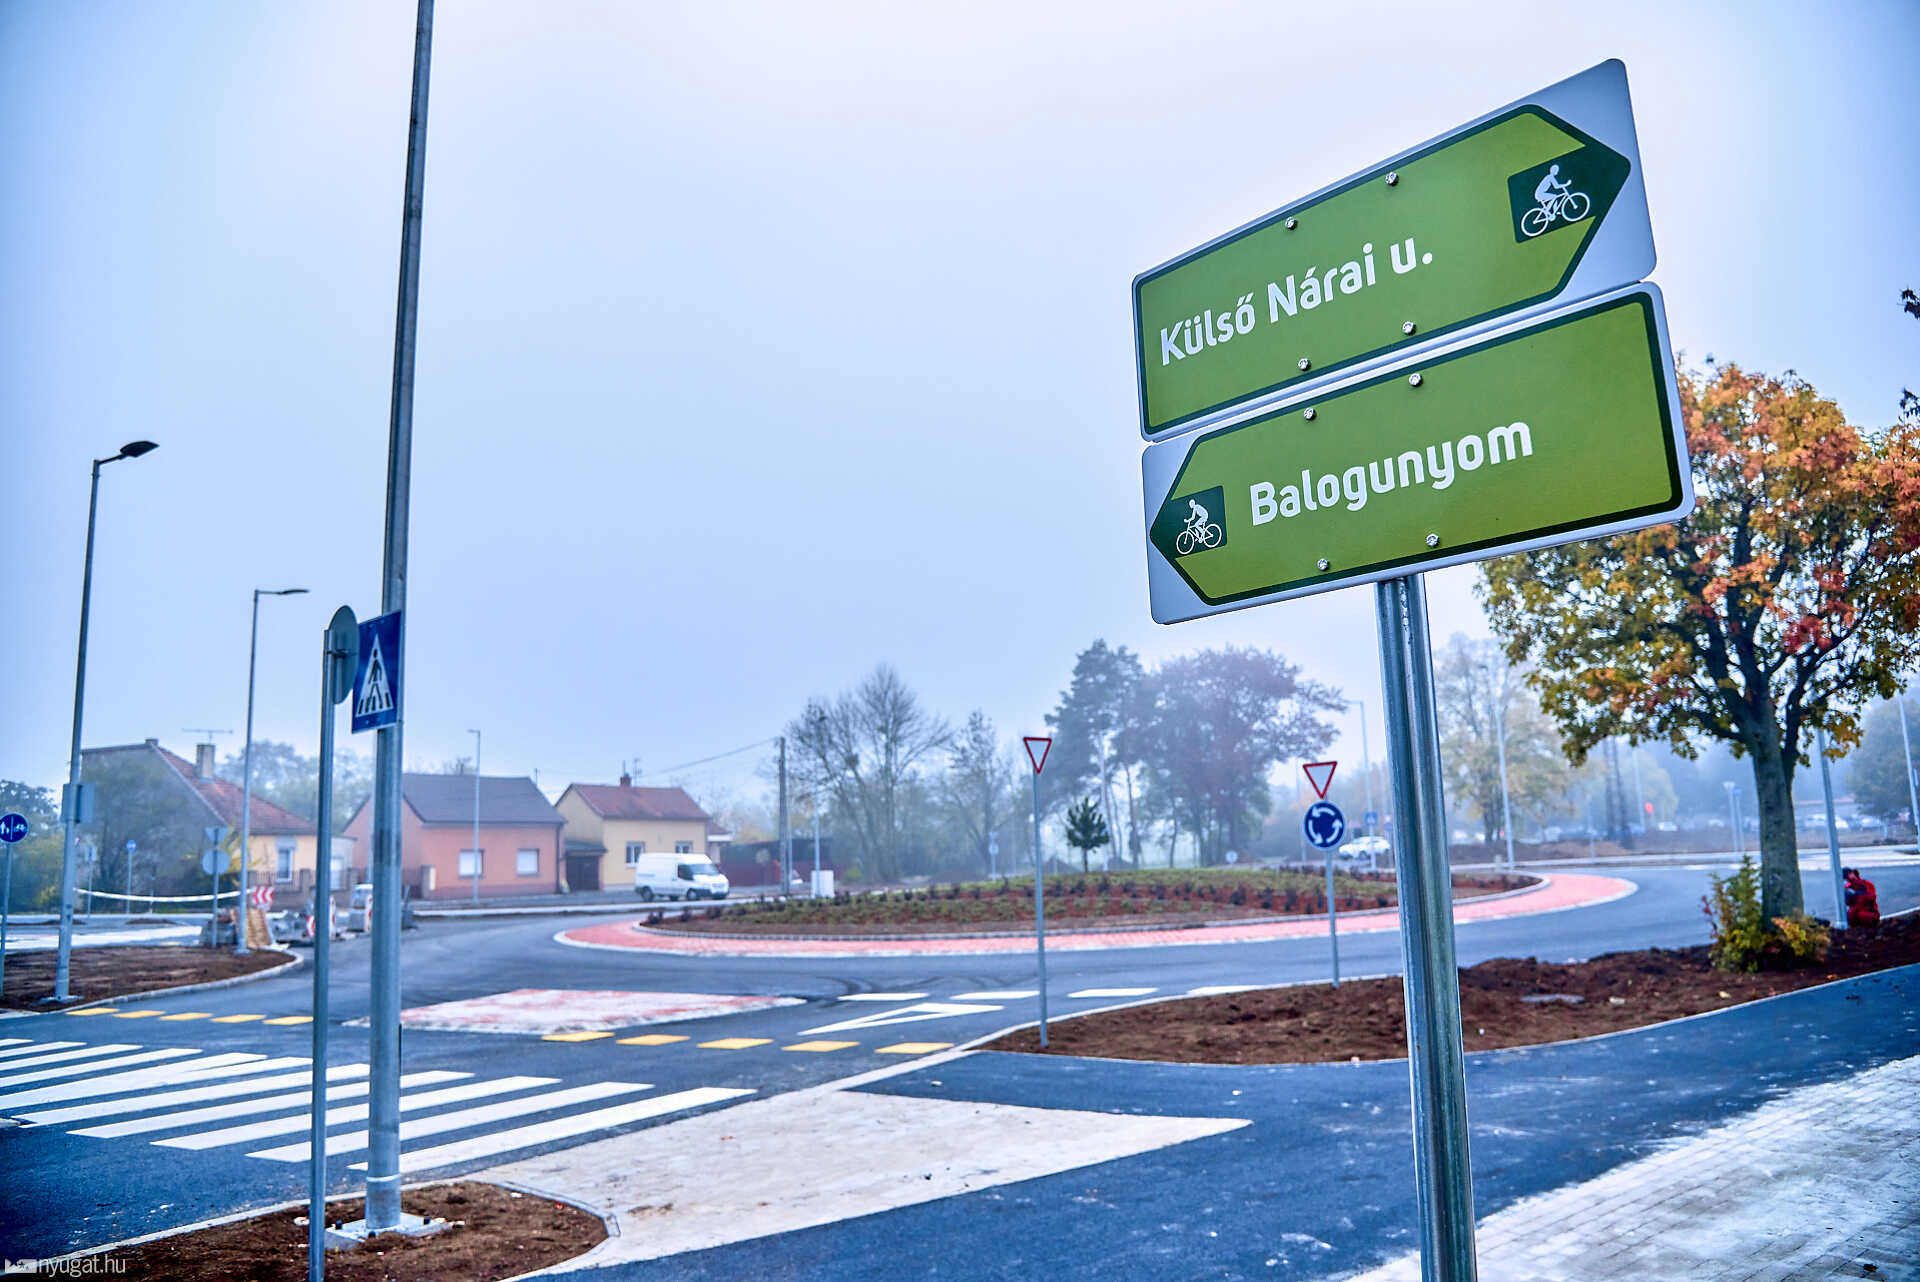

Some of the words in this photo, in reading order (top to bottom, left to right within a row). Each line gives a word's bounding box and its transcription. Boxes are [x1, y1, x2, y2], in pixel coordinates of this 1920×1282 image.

[1160, 294, 1256, 365] Külső
[1267, 243, 1376, 323] Nárai
[1390, 238, 1433, 274] u.
[1250, 421, 1533, 526] Balogunyom
